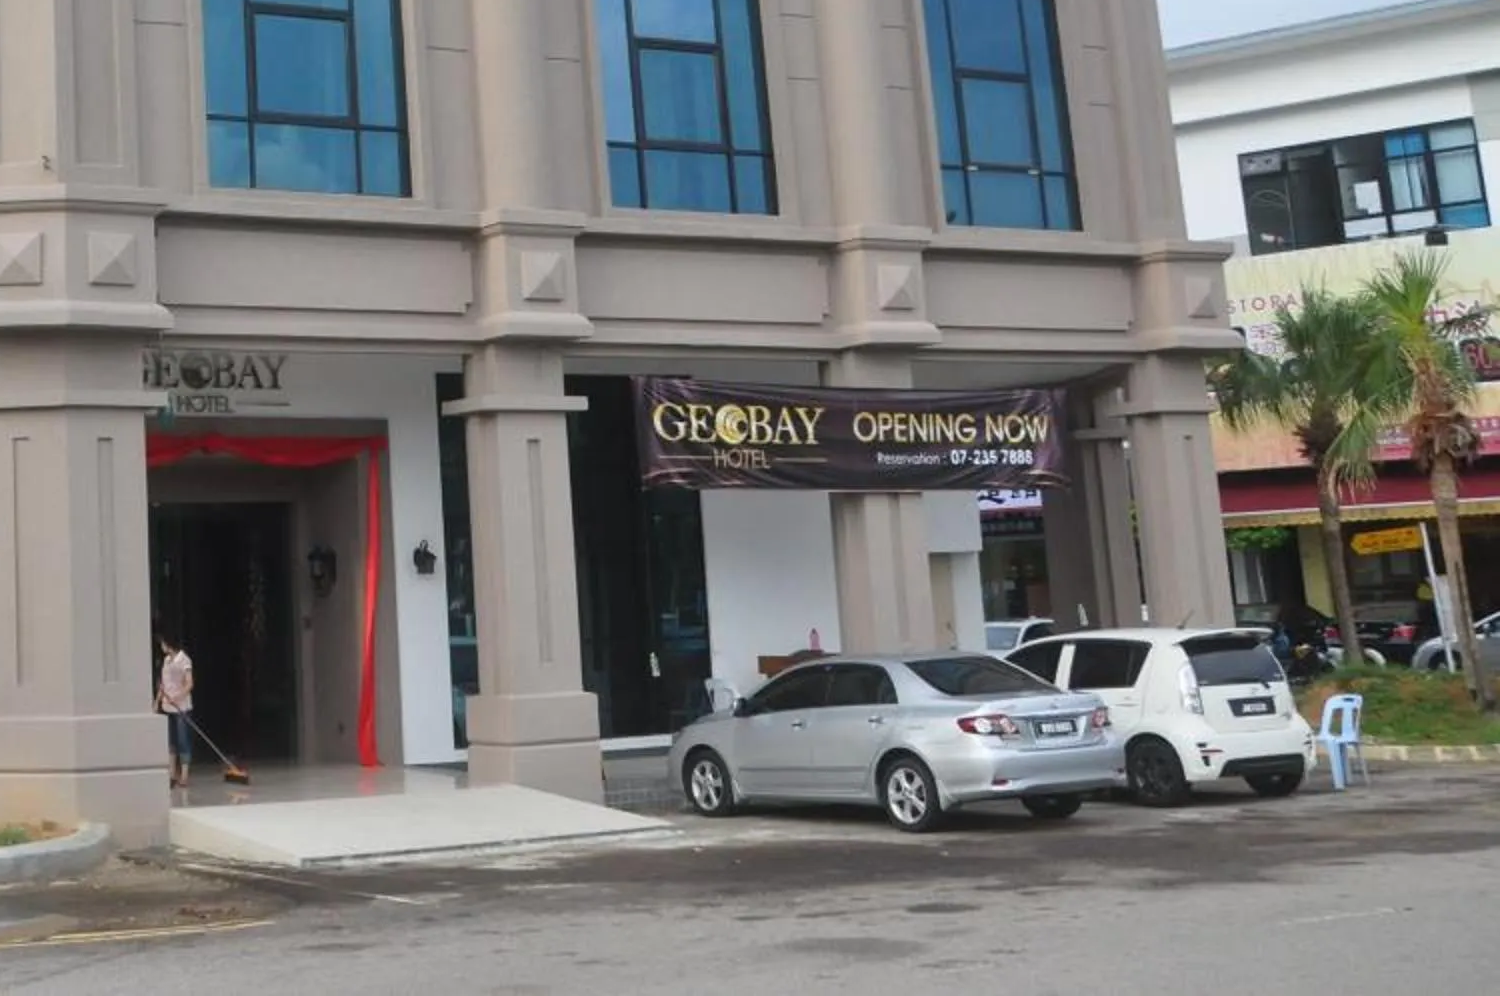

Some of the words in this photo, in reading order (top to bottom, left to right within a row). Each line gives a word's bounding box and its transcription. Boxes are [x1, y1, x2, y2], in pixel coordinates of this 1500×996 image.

[652, 403, 826, 446] GEOBAY
[853, 411, 977, 443] OPENING
[984, 412, 1050, 445] NOW
[712, 447, 772, 470] HOTEL
[876, 451, 941, 467] Reservation
